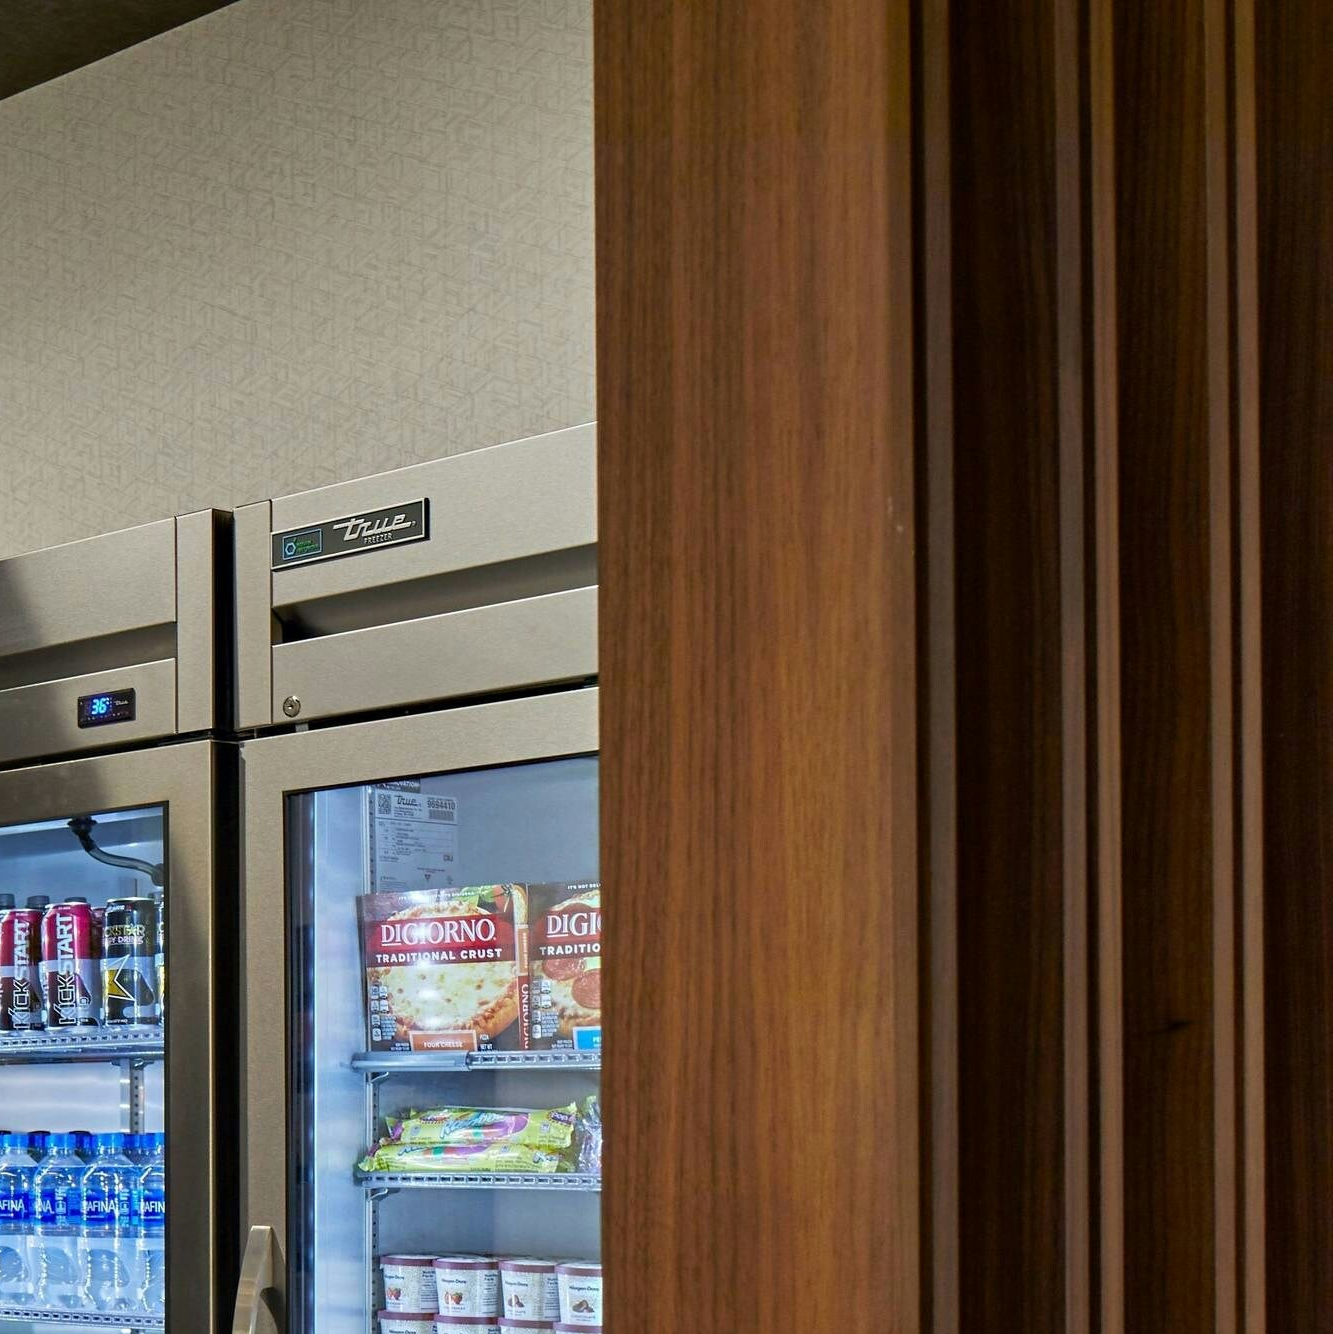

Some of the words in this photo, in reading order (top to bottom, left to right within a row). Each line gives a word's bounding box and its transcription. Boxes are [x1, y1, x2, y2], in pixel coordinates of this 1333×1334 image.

[363, 533, 393, 545] FREEZER
[546, 912, 601, 938] DIGI
[376, 951, 456, 963] TRADITIONAL
[460, 948, 503, 960] CRUST
